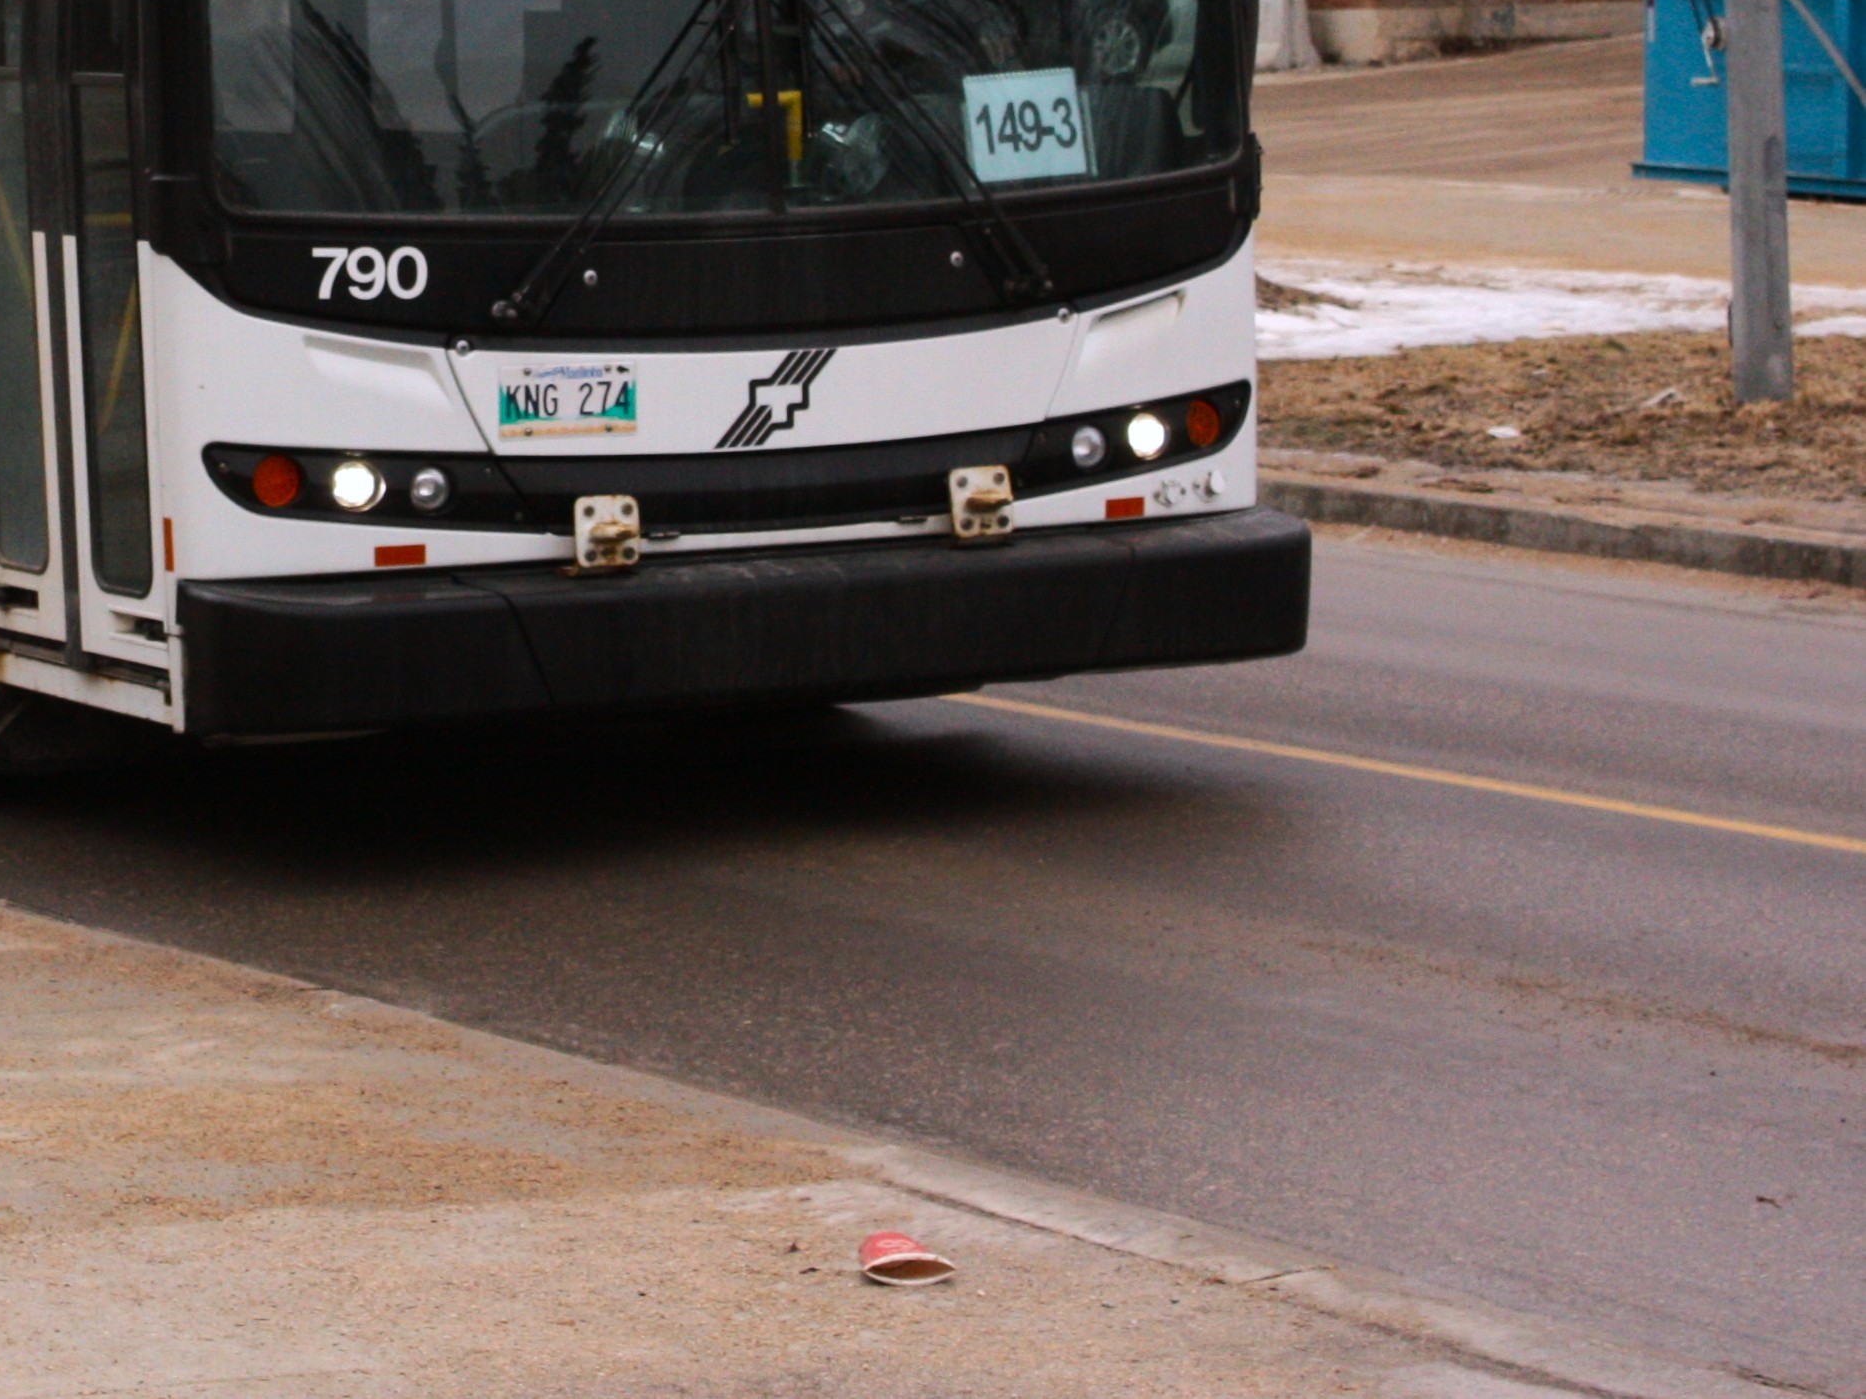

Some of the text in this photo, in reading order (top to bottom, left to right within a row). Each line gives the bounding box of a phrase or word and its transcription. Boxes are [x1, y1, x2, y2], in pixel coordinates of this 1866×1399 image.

[976, 98, 1077, 155] 149-3
[312, 246, 428, 300] 790
[505, 381, 630, 419] KNG 274
